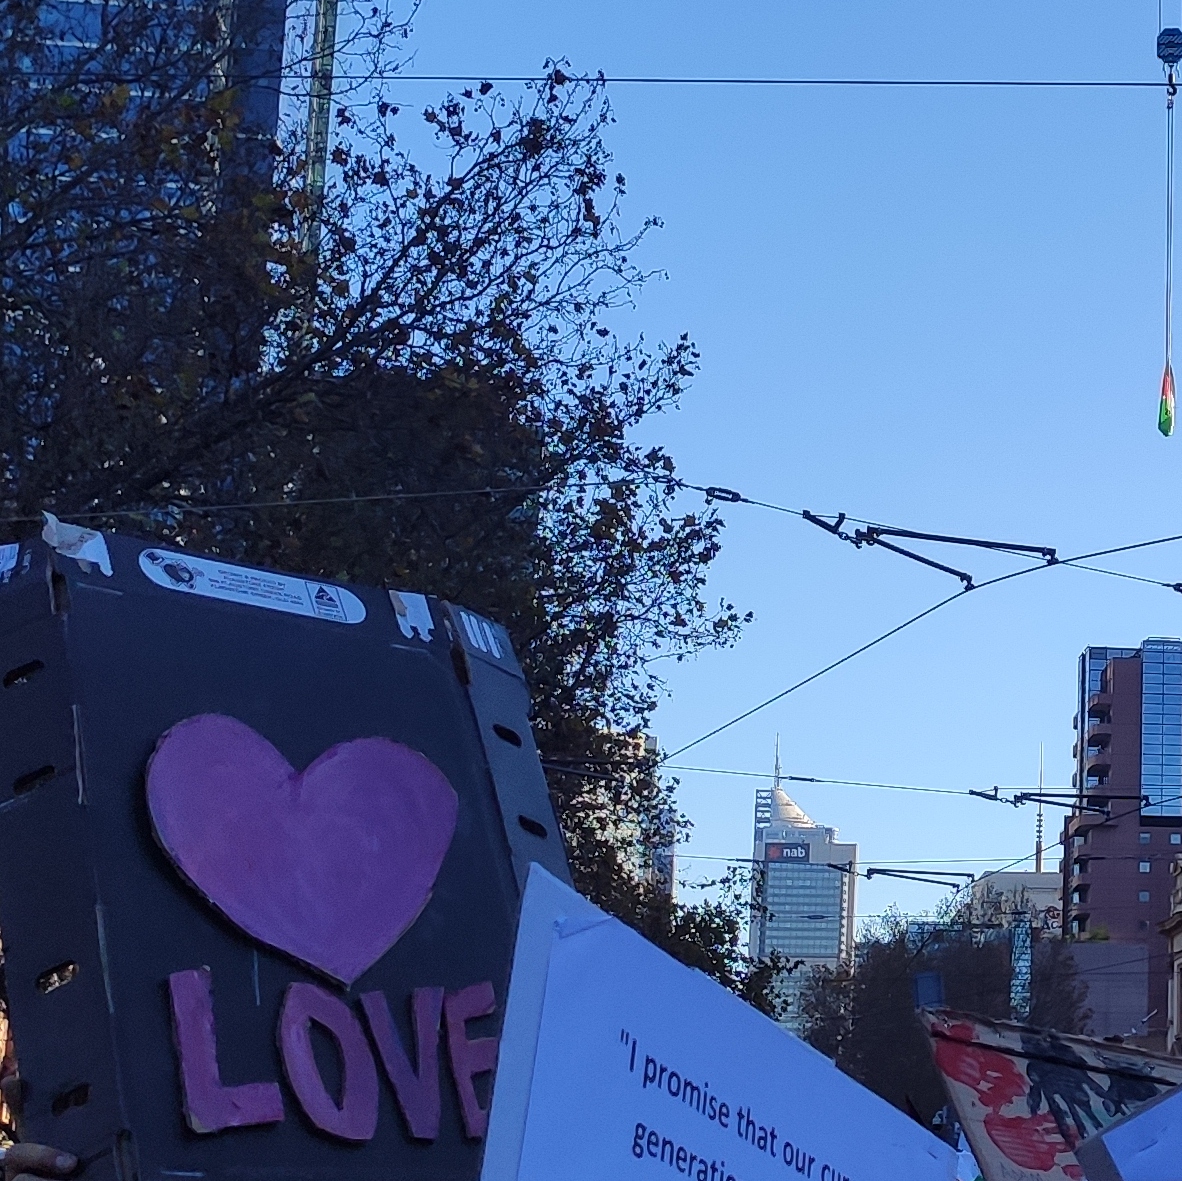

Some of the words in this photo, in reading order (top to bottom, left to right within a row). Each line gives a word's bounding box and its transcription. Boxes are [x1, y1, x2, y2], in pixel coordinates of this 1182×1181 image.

[783, 846, 806, 858] nab
[169, 966, 498, 1140] LOVE
[631, 1122, 737, 1181] generati
[642, 1054, 730, 1129] promise
[736, 1104, 777, 1158] that
[782, 1141, 816, 1179] our
